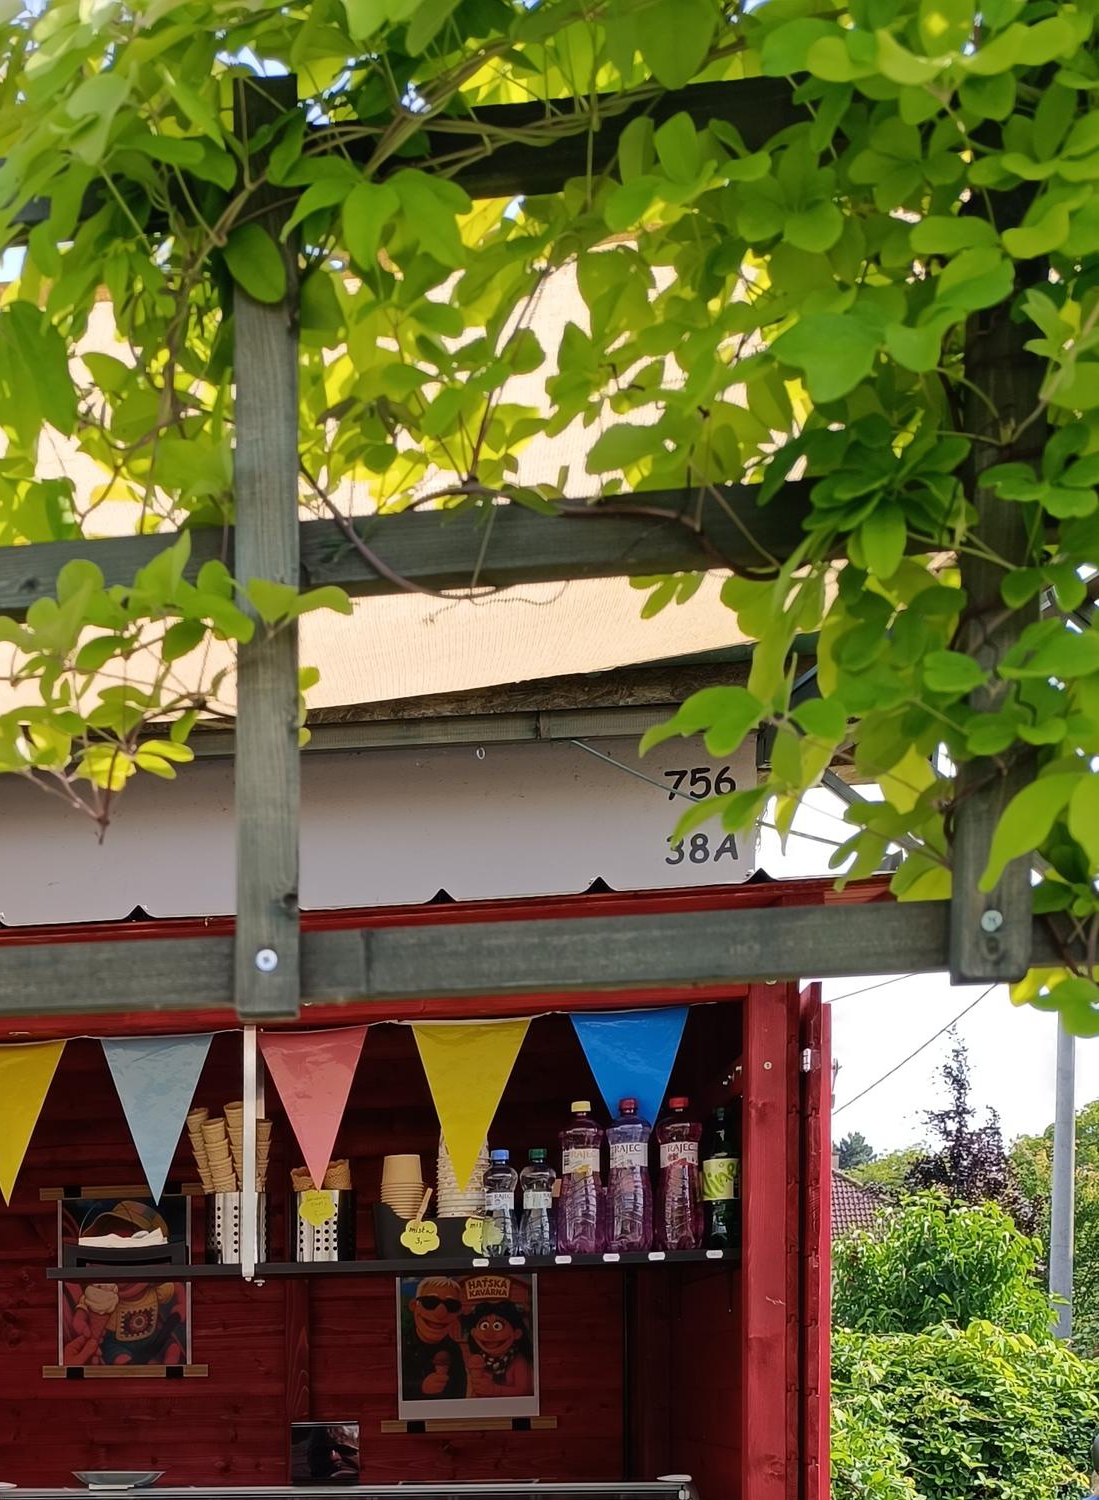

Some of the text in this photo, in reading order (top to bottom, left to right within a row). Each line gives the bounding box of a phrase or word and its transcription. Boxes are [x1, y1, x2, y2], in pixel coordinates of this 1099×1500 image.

[664, 766, 737, 801] 756
[665, 832, 739, 865] 38A
[615, 1144, 641, 1154] RAJEC
[668, 1143, 694, 1153] RAJEC
[469, 1287, 508, 1298] KAVÁRNA
